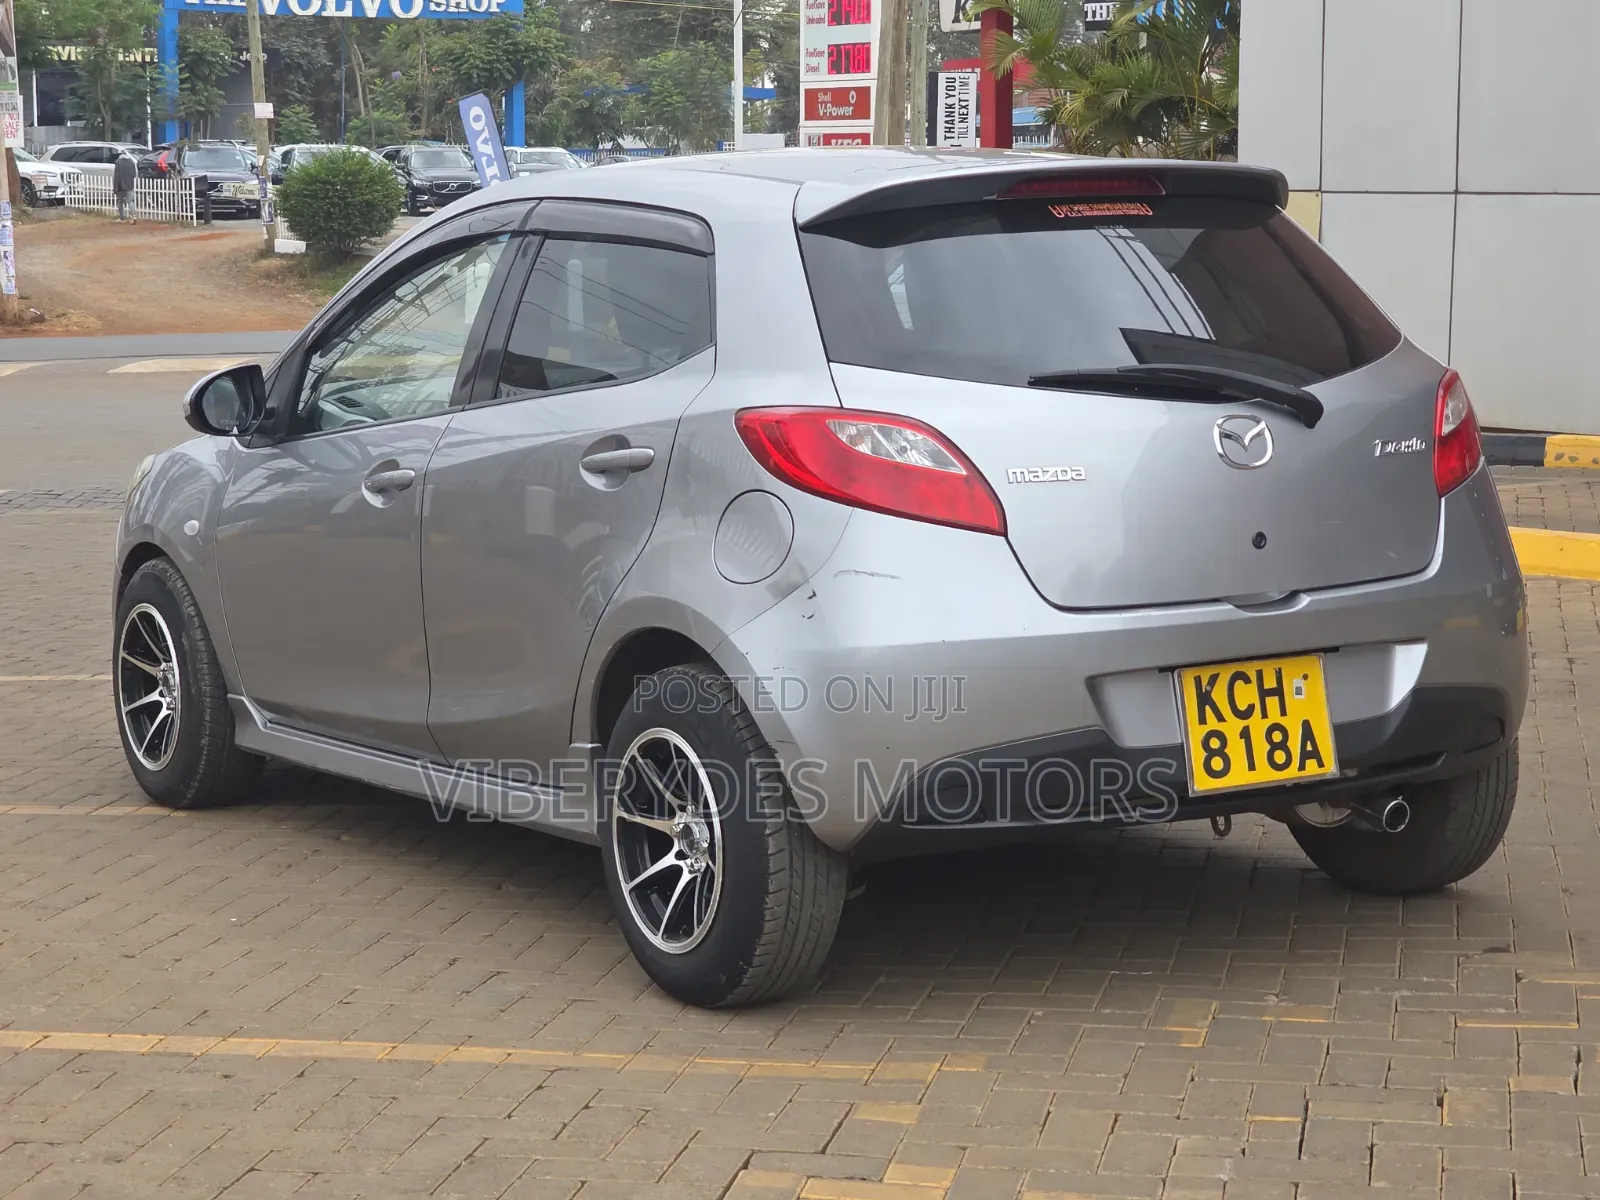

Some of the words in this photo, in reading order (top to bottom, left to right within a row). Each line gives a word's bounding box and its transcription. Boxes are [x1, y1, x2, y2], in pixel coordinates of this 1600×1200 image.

[240, 51, 267, 60] Jep
[806, 62, 820, 73] Diesel
[945, 77, 957, 100] YOU
[958, 75, 970, 96] TIME
[818, 92, 832, 102] Shell
[818, 103, 854, 117] V-Power
[958, 98, 970, 123] NEXT
[944, 103, 956, 141] THANK
[957, 125, 969, 140] TILL
[1194, 667, 1288, 726] KCH
[1201, 719, 1325, 779] 818A
